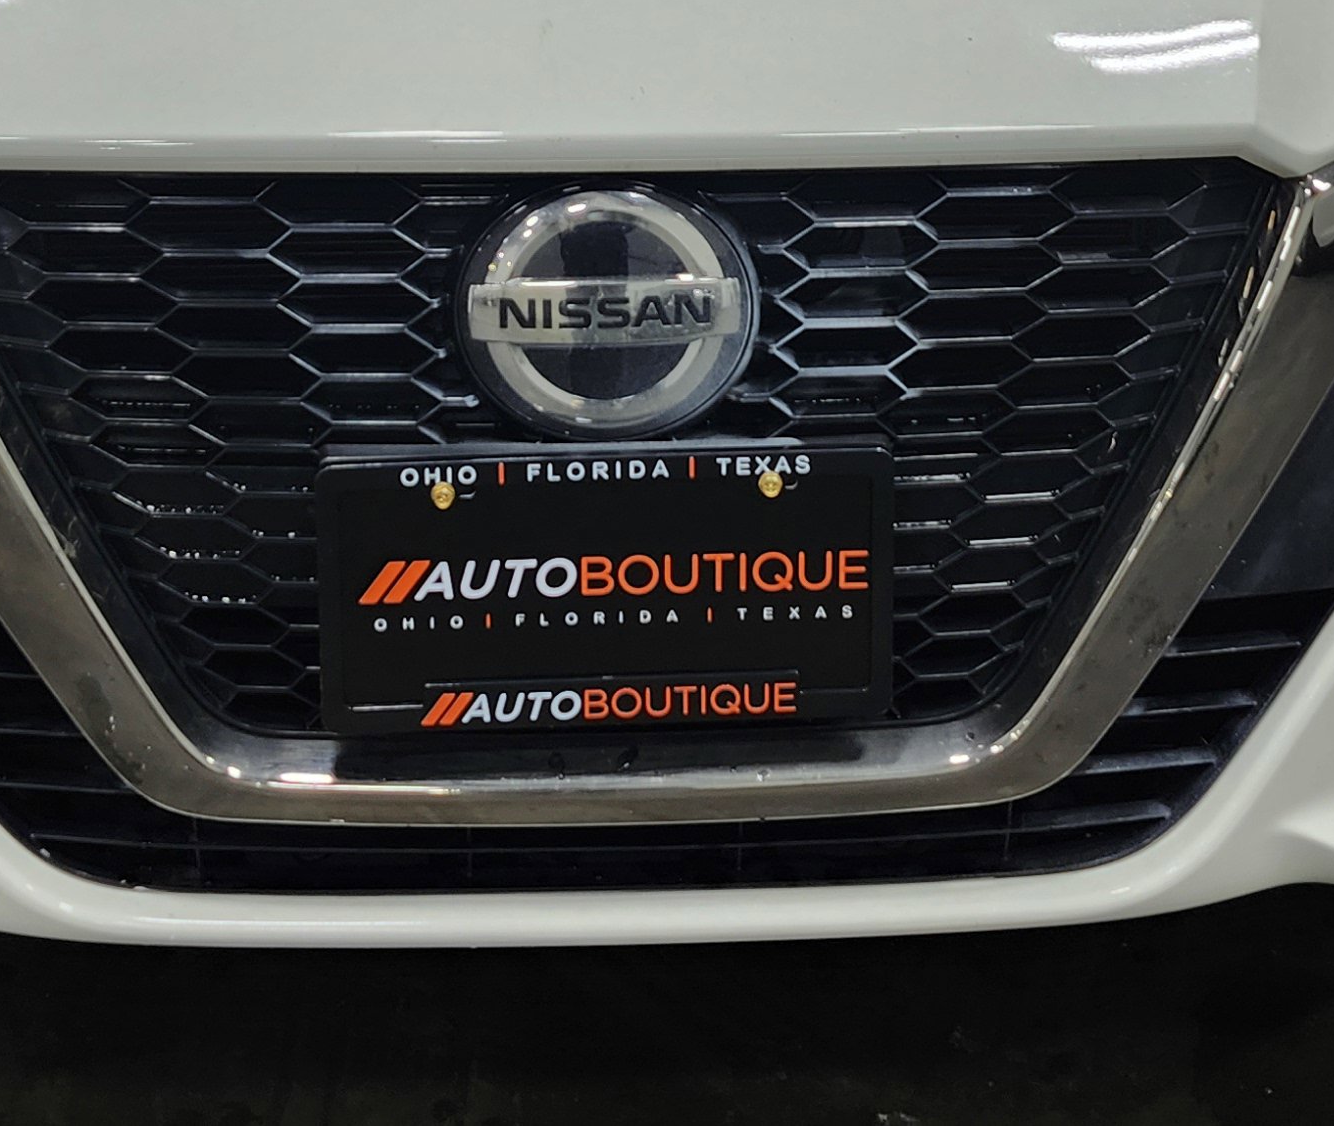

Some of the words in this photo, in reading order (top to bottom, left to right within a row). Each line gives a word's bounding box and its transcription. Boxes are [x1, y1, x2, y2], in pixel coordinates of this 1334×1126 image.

[498, 292, 712, 329] NISSAN
[400, 465, 477, 487] OHIO
[526, 459, 670, 482] FLORIDA
[716, 454, 811, 475] TEXAS
[414, 550, 869, 601] AUTOBOUTIQUE
[374, 615, 464, 632] OHIO
[515, 609, 679, 627] FLORIDA
[737, 604, 854, 622] TEXAS
[462, 682, 797, 723] AUTOBOUTIQUE
